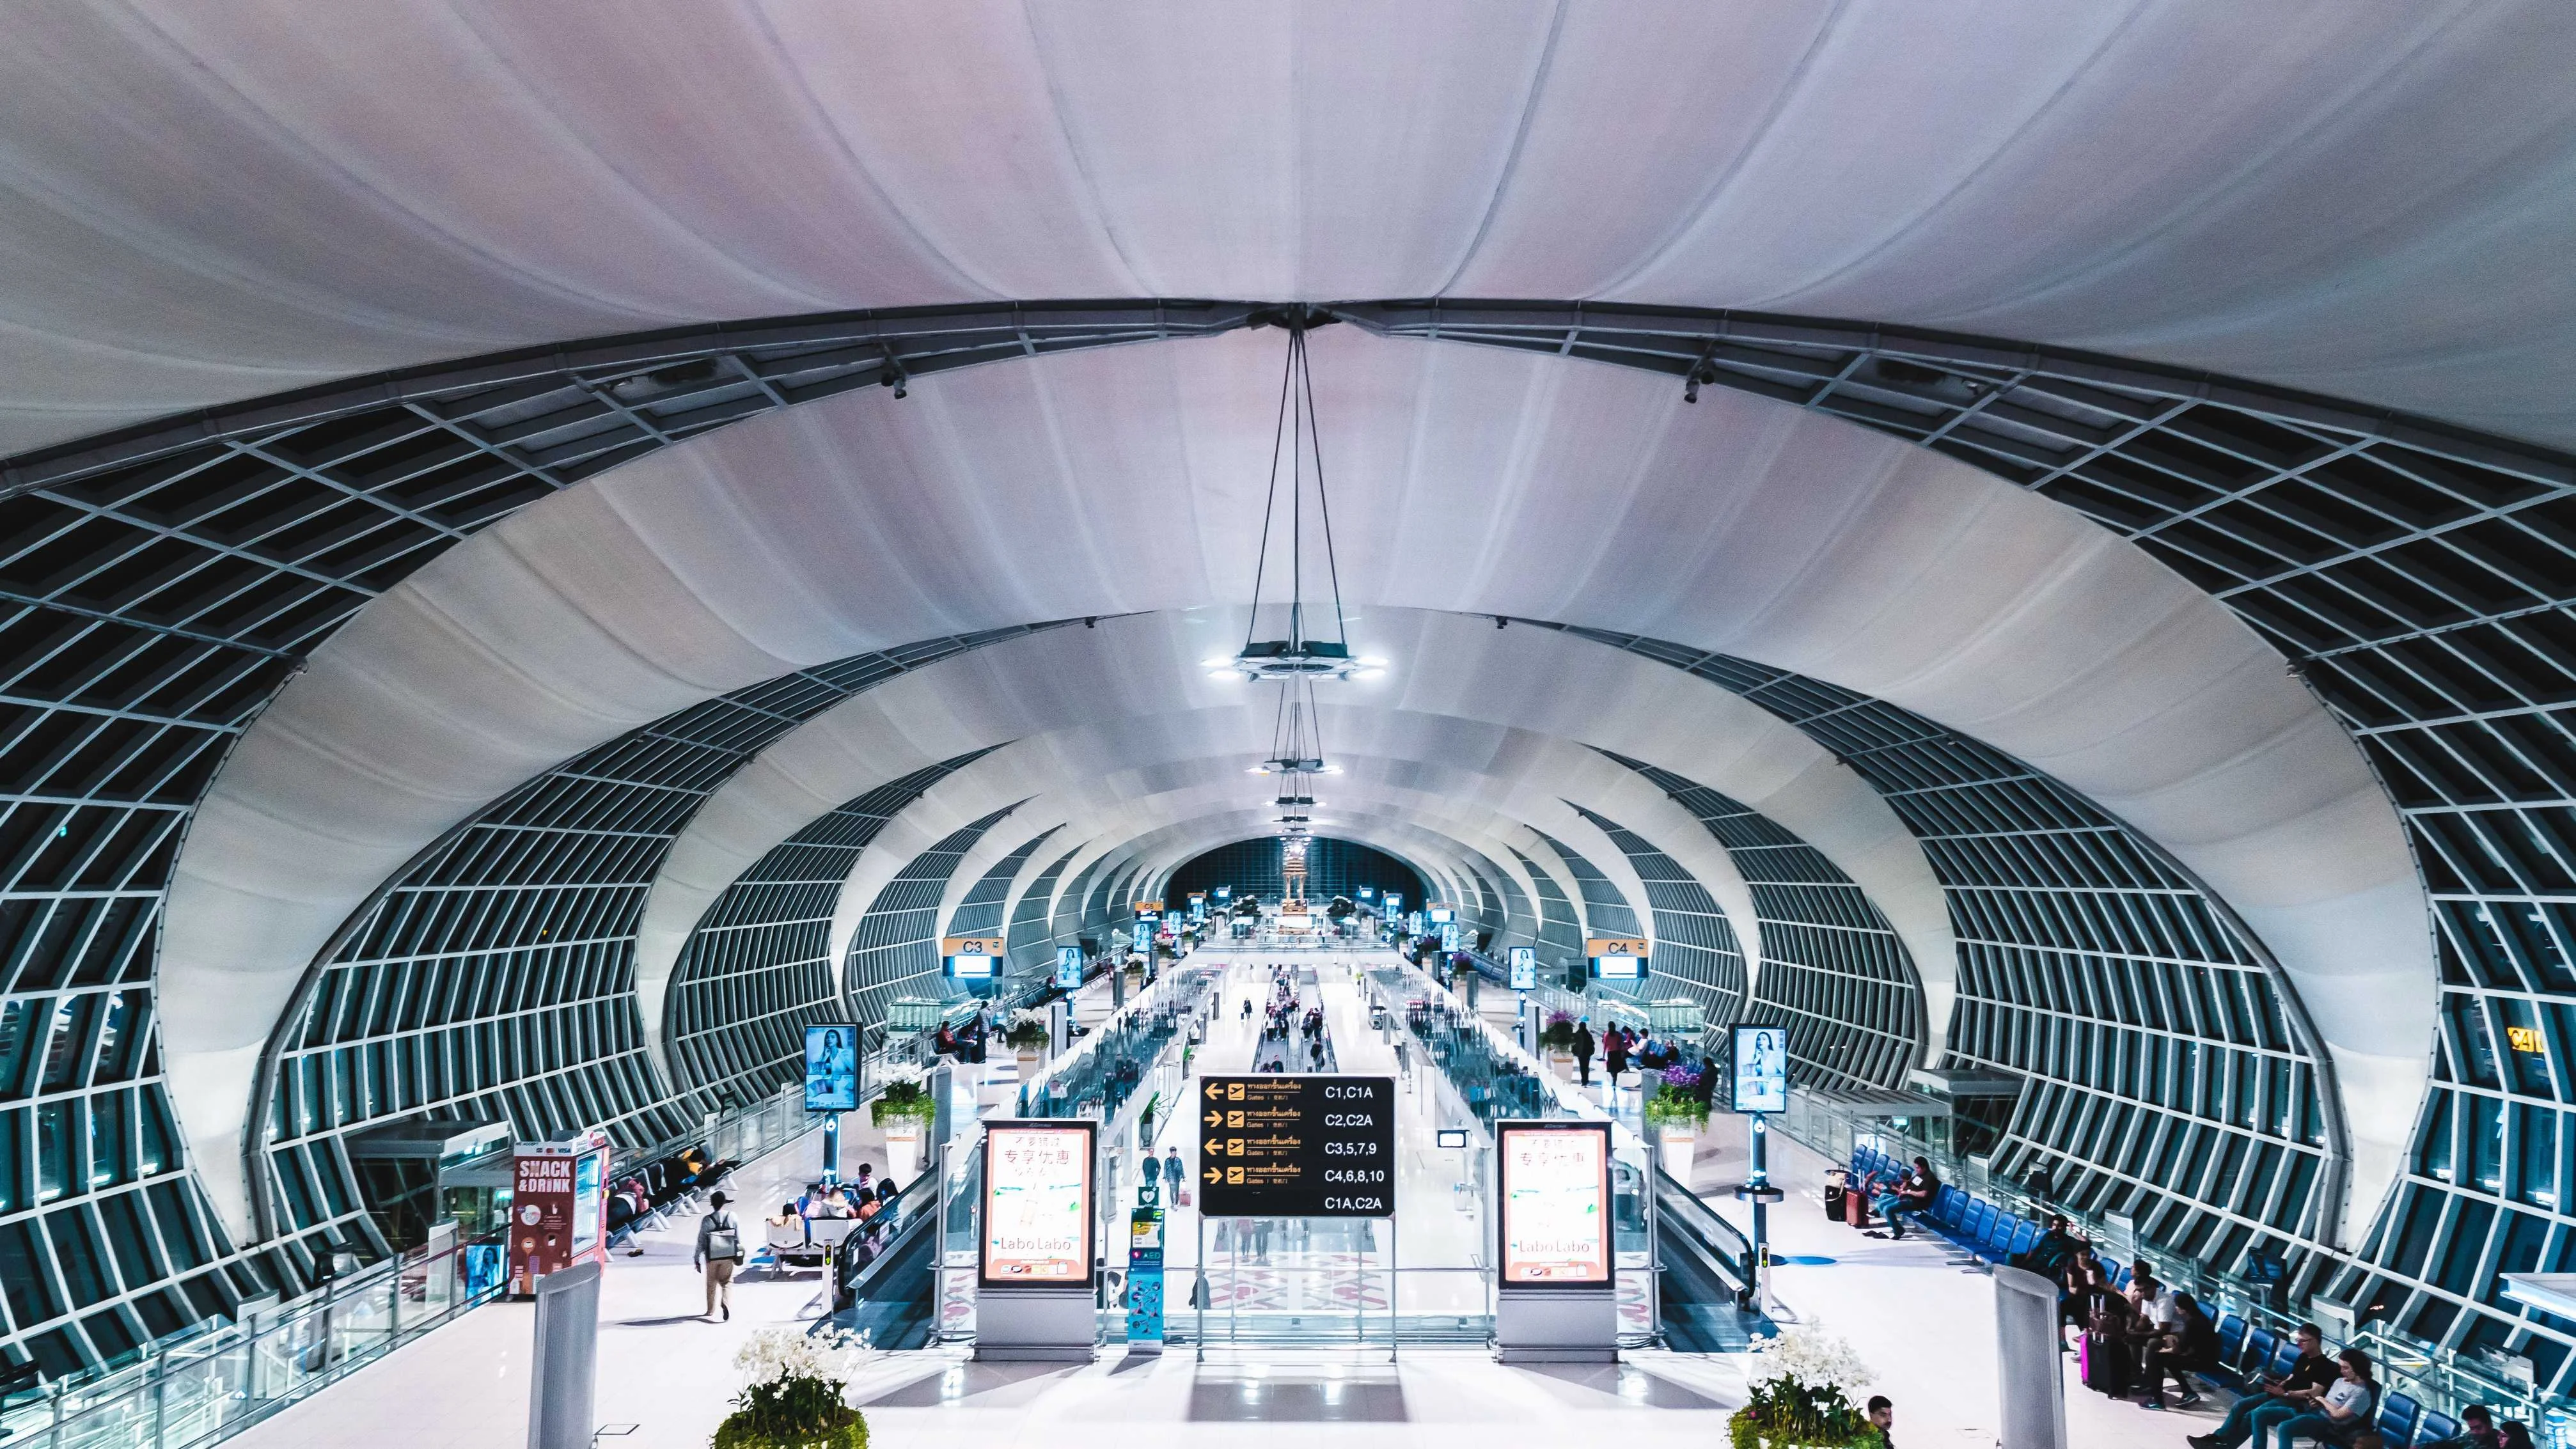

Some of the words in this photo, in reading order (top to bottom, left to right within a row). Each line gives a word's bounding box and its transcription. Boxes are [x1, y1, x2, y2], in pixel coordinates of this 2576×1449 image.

[963, 941, 982, 953] C3
[1608, 943, 1628, 954] C4
[1005, 1150, 1070, 1164] 专享优惠
[519, 1161, 571, 1178] SNACK
